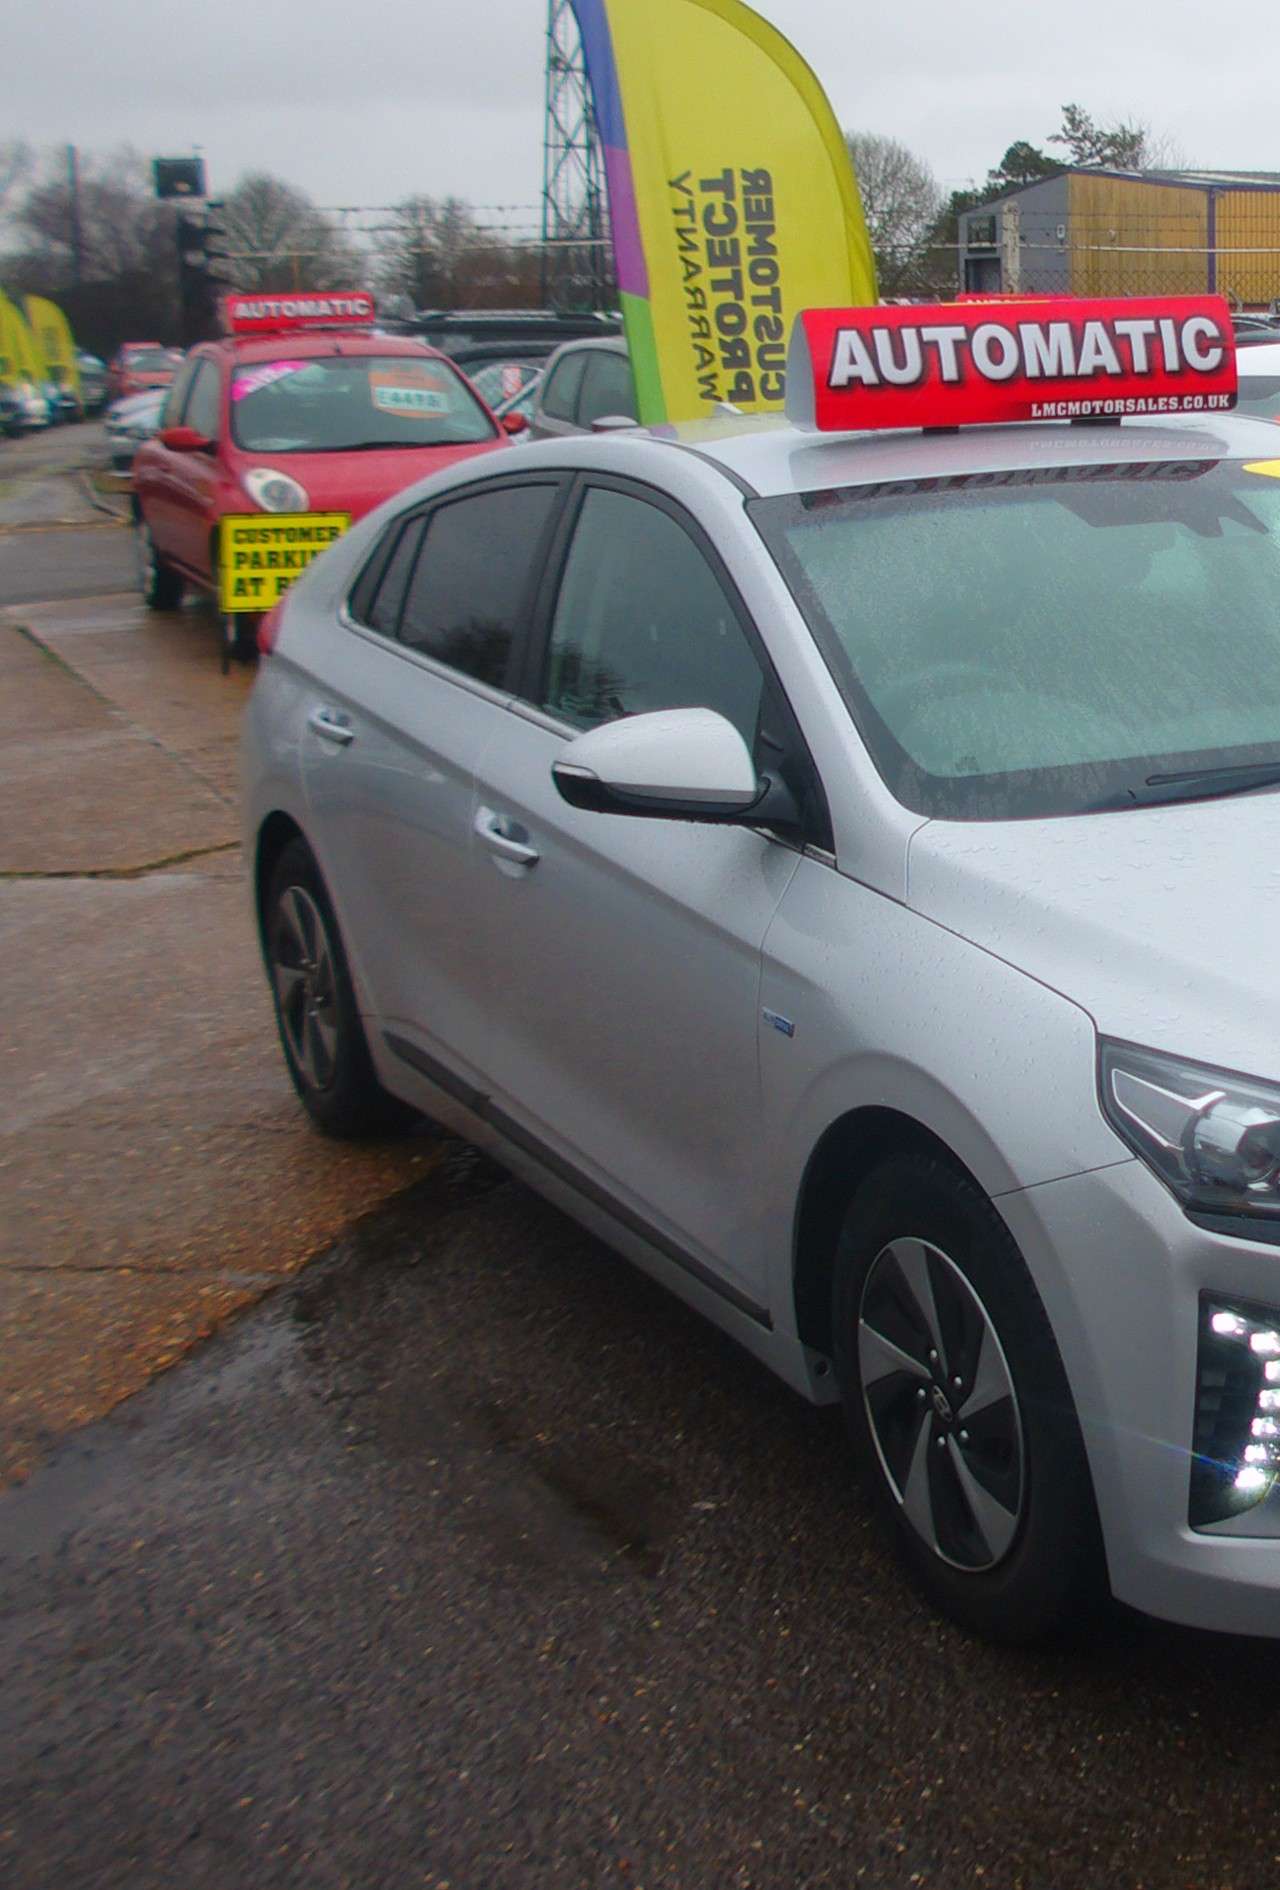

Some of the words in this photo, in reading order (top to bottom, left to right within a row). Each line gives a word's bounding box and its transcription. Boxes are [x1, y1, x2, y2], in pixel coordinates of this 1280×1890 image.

[233, 299, 371, 319] AUTOMATIC
[829, 316, 1223, 387] AUTOMATIC
[1031, 394, 1230, 418] LMCMOTORSALES.CO.UK
[234, 527, 340, 545] CUSTOMER
[234, 577, 264, 597] AT
